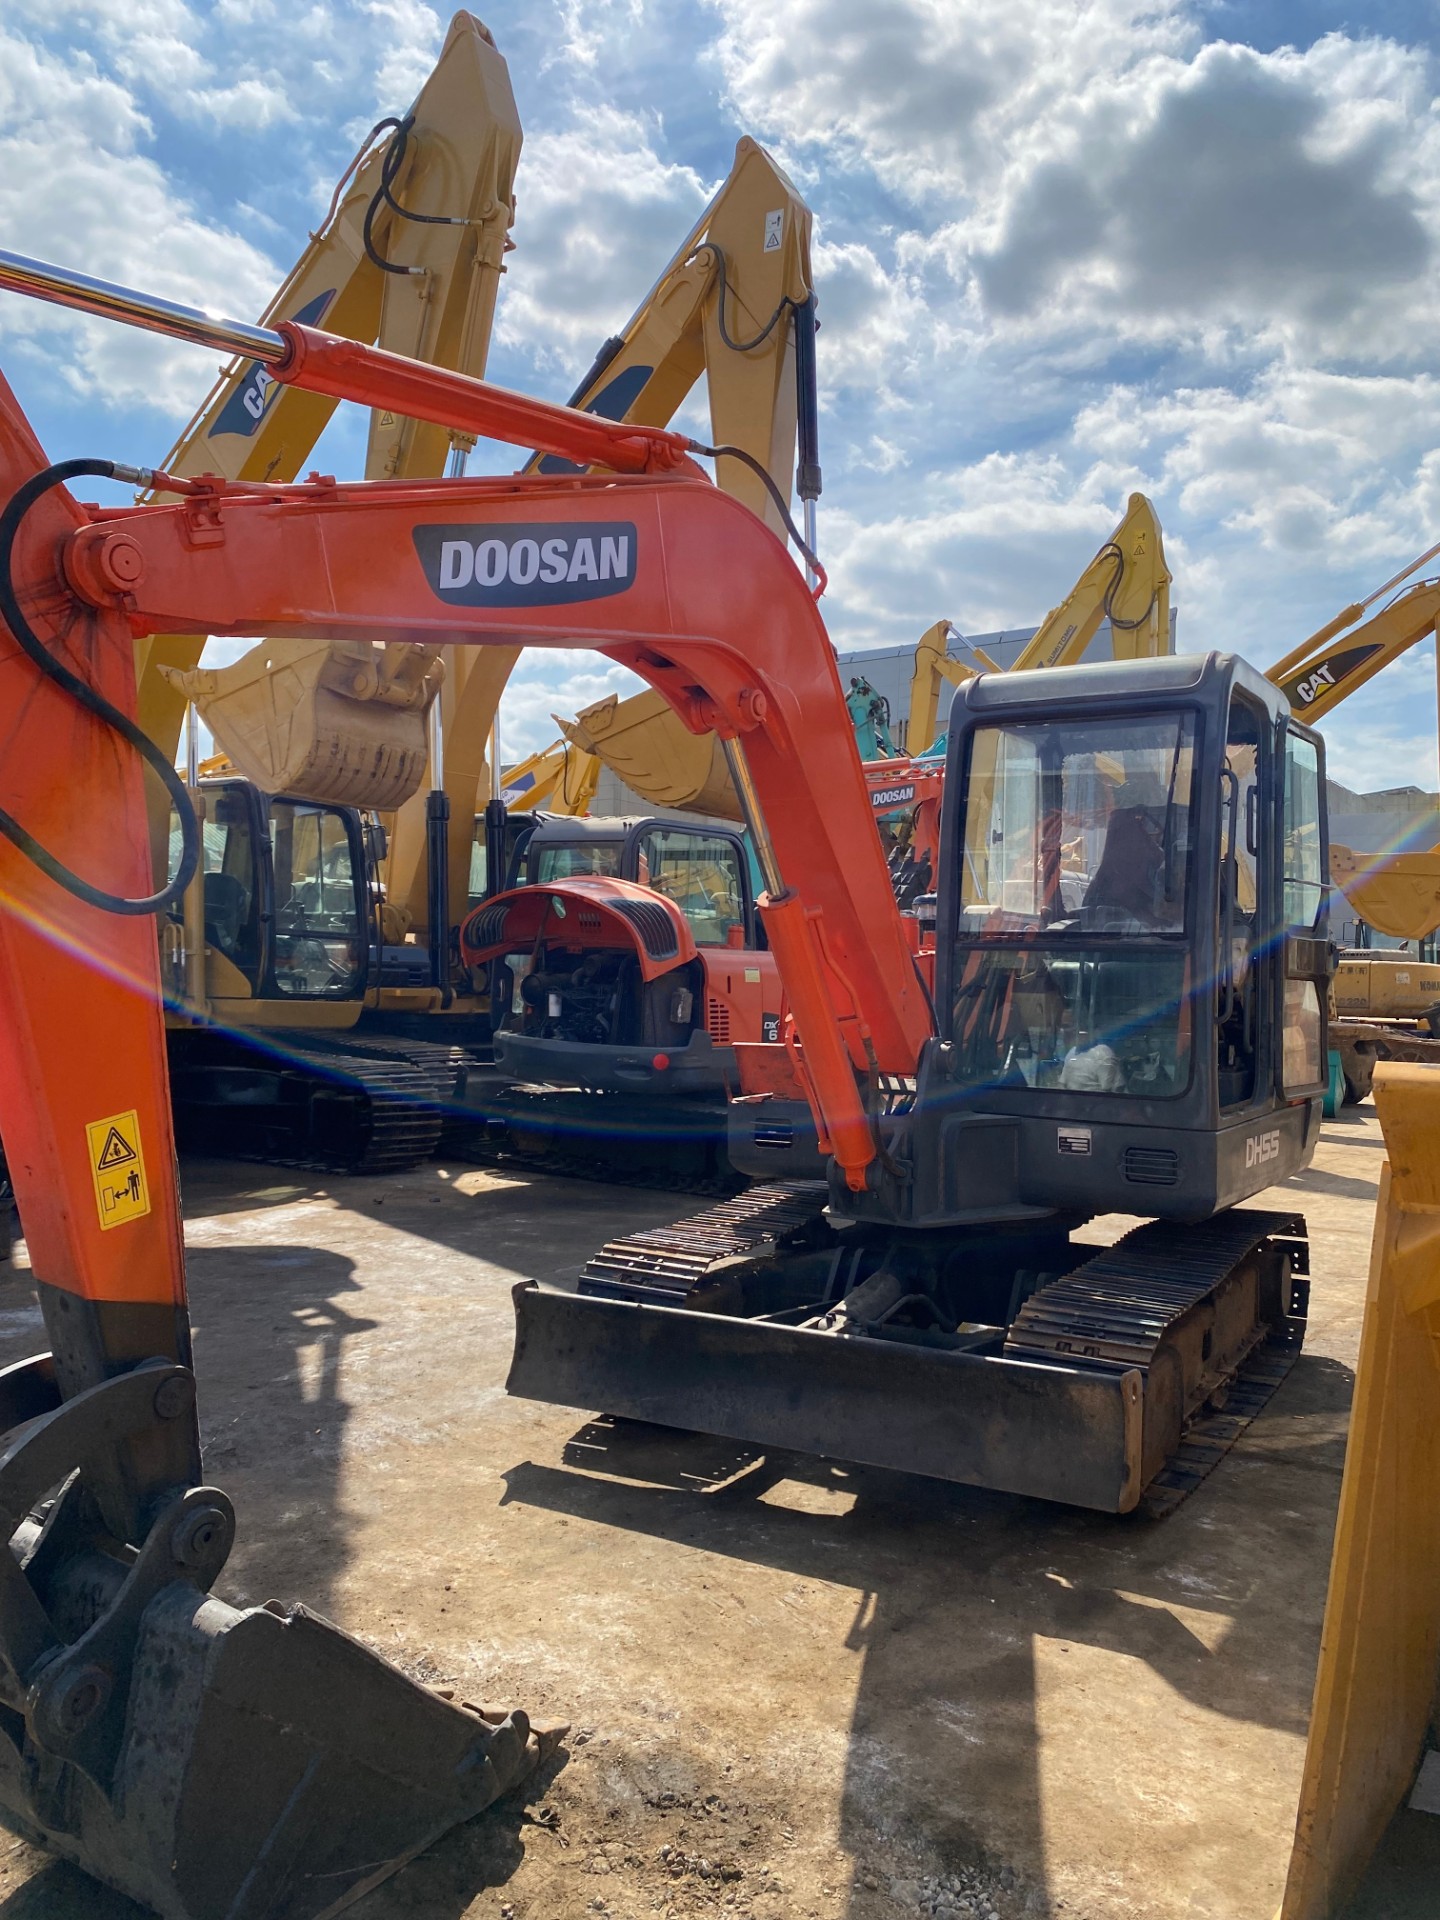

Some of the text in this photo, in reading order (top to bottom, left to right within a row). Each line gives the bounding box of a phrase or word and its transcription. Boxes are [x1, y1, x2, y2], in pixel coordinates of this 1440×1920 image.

[243, 362, 275, 419] CA
[439, 535, 629, 590] DOOSAN
[1296, 664, 1336, 703] CAT
[872, 787, 914, 806] DOOSAN
[1246, 1129, 1280, 1168] DH55
